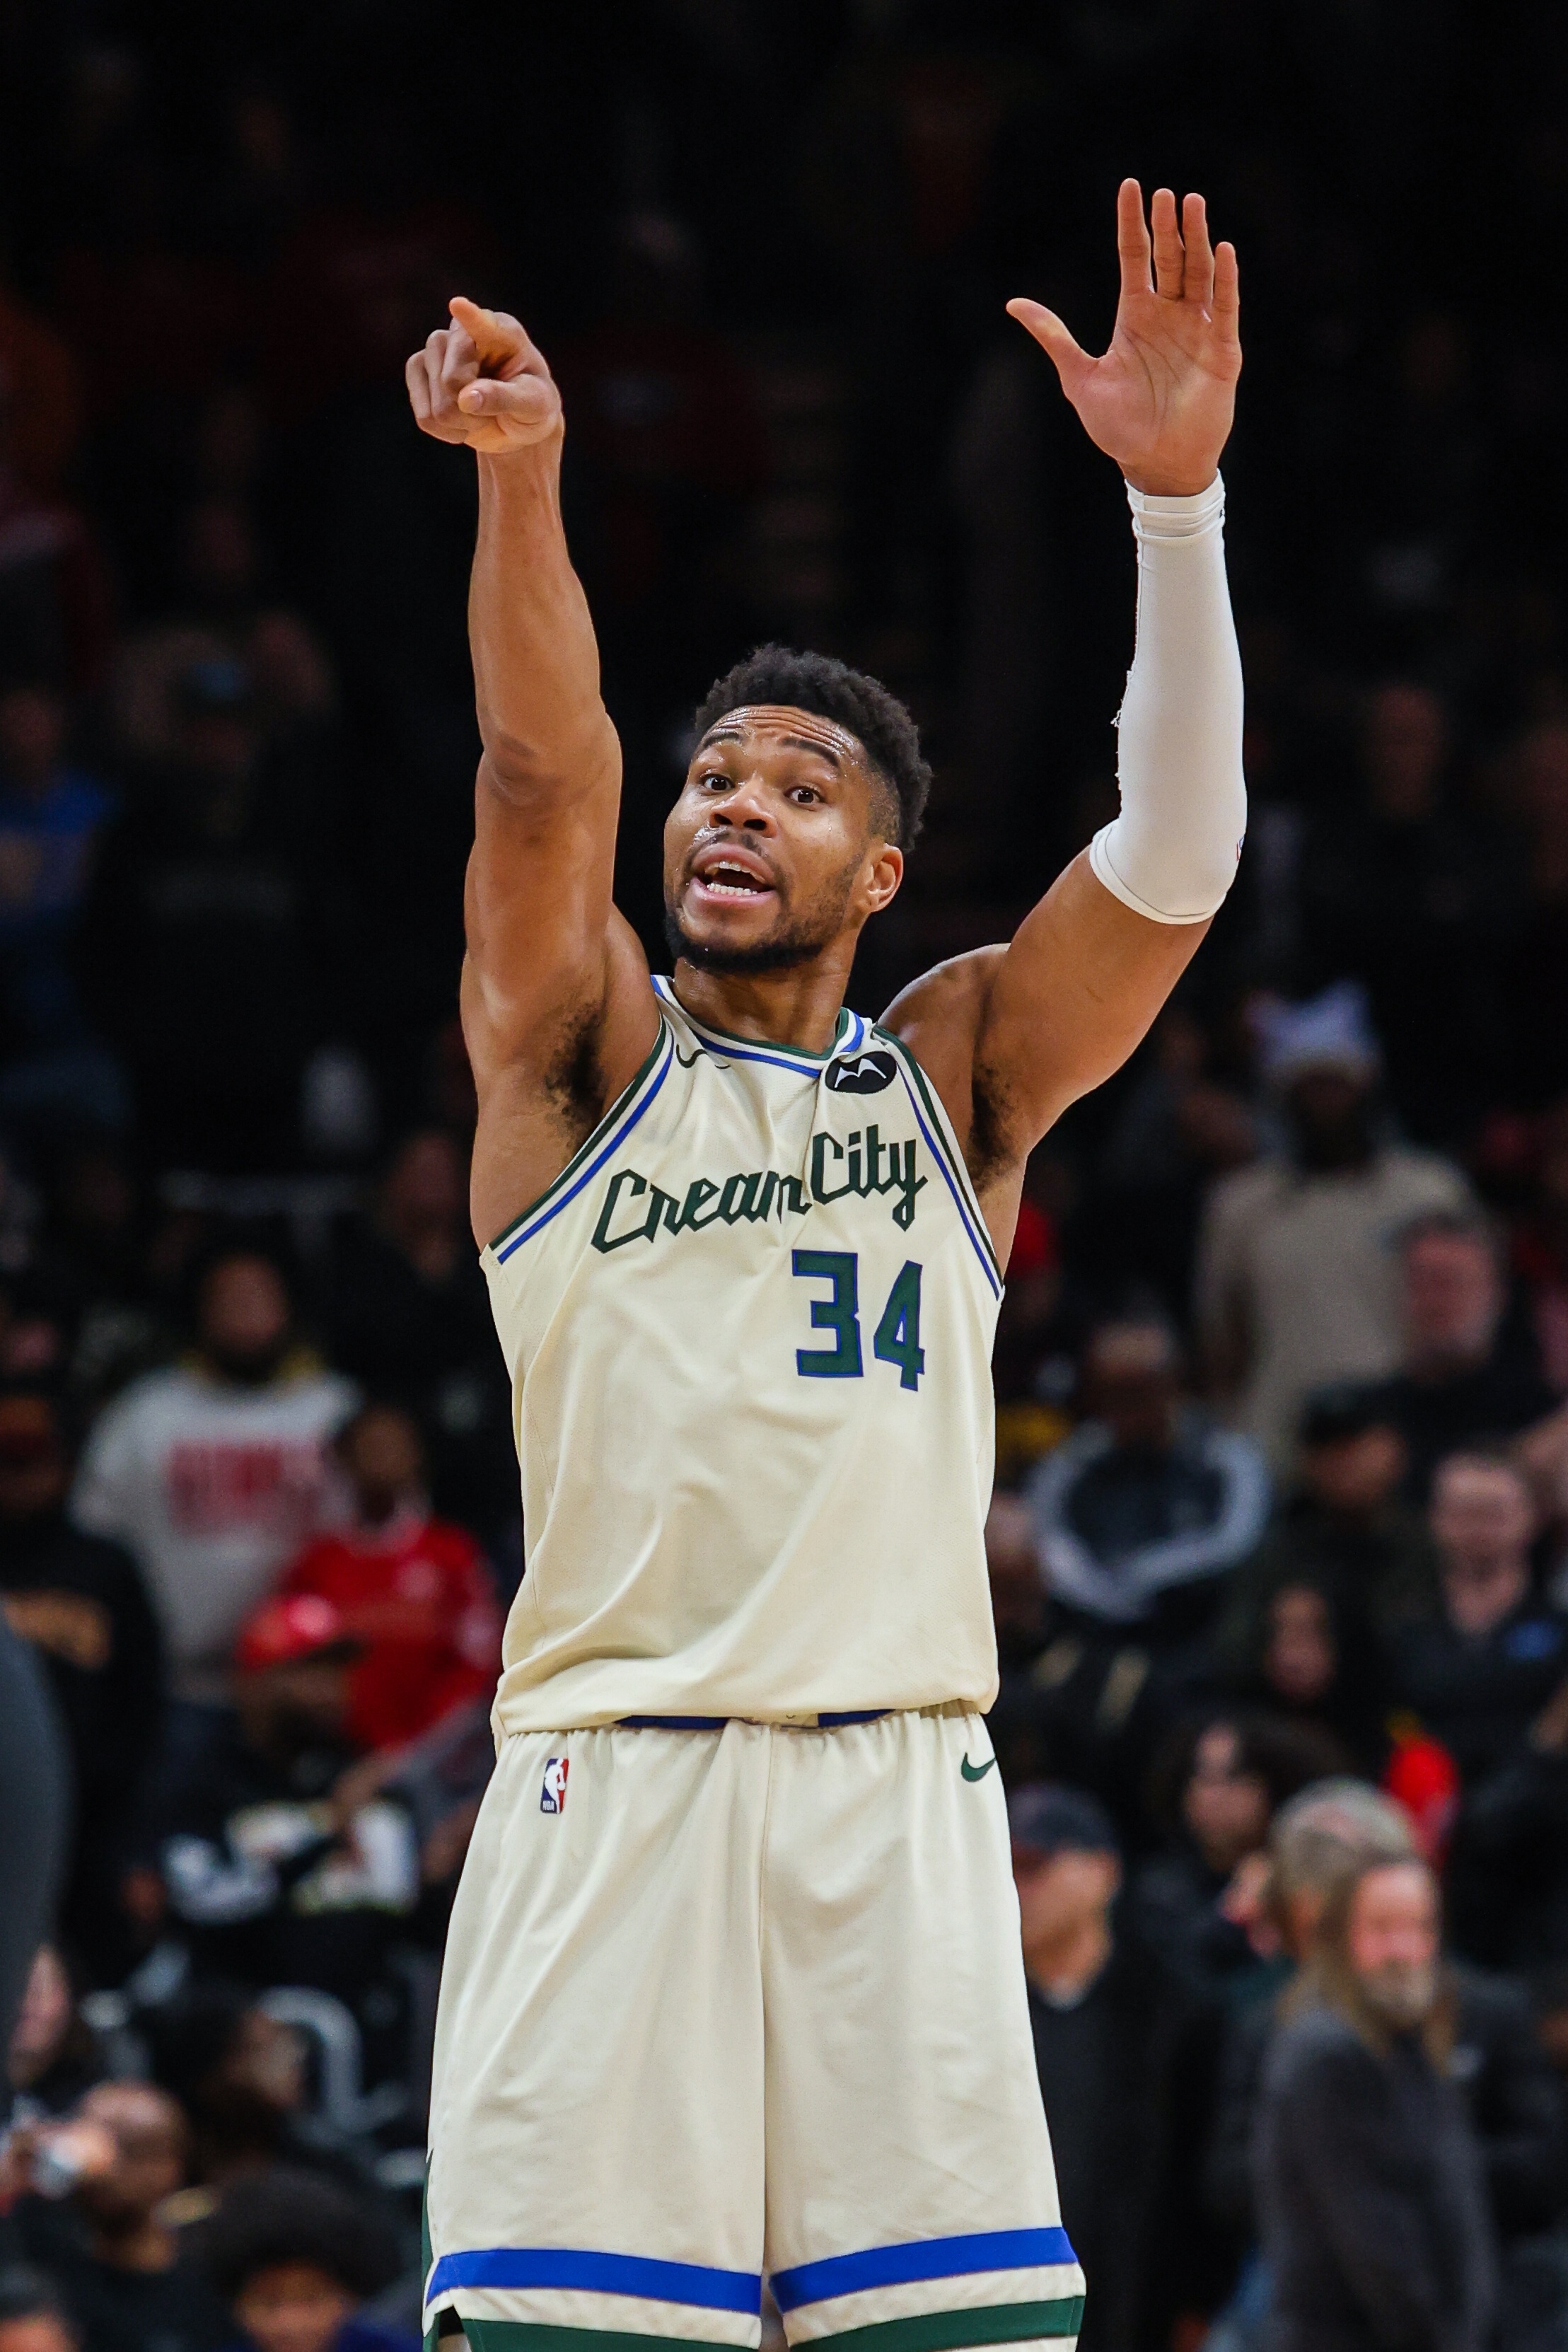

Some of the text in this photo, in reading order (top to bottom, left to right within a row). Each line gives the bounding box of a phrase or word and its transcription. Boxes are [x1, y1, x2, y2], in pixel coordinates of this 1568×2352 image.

[591, 1124, 928, 1253] Cream City
[791, 1249, 925, 1391] 34
[542, 1800, 554, 1812] NBA
